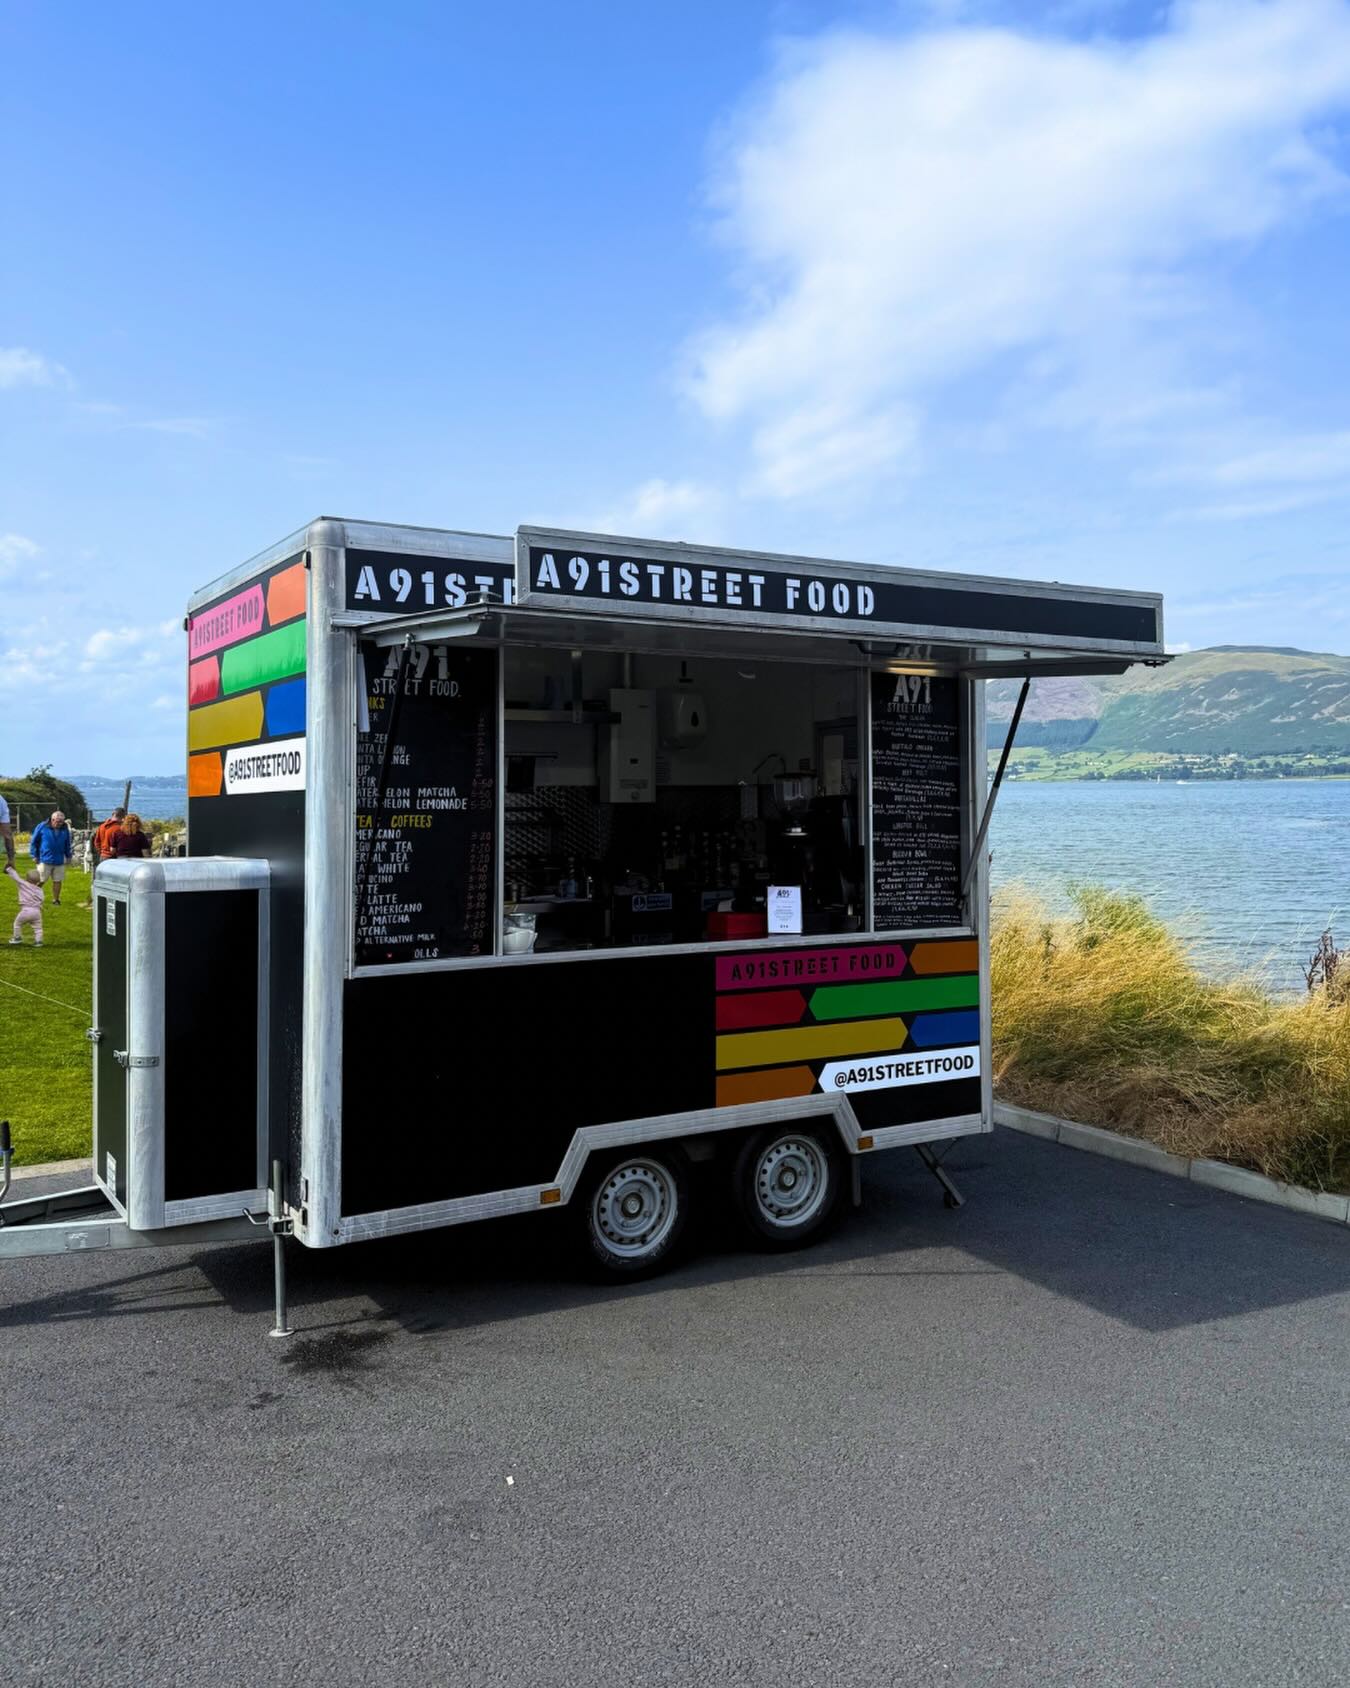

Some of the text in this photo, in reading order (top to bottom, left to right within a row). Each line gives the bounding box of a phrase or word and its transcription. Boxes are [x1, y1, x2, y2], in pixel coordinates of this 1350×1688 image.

[536, 553, 875, 616] A91STREET FOOD
[193, 595, 260, 649] A91STREET FOOD
[372, 678, 421, 696] STRET
[893, 675, 932, 704] A91
[228, 750, 301, 784] @A91STREETFOOD
[417, 786, 457, 798] MATCHA
[416, 797, 468, 810] LEMONADE
[389, 815, 433, 829] COFFEES
[394, 841, 414, 853] TEA
[389, 852, 409, 863] TEA
[377, 862, 411, 874] WHITE
[367, 894, 399, 905] LATTE
[368, 902, 423, 916] AMERICANO
[372, 914, 411, 926] MATCHA
[413, 947, 440, 959] OLLS
[731, 952, 895, 981] A91STREET FOOD
[834, 1054, 975, 1088] @A91STREETFOOD
